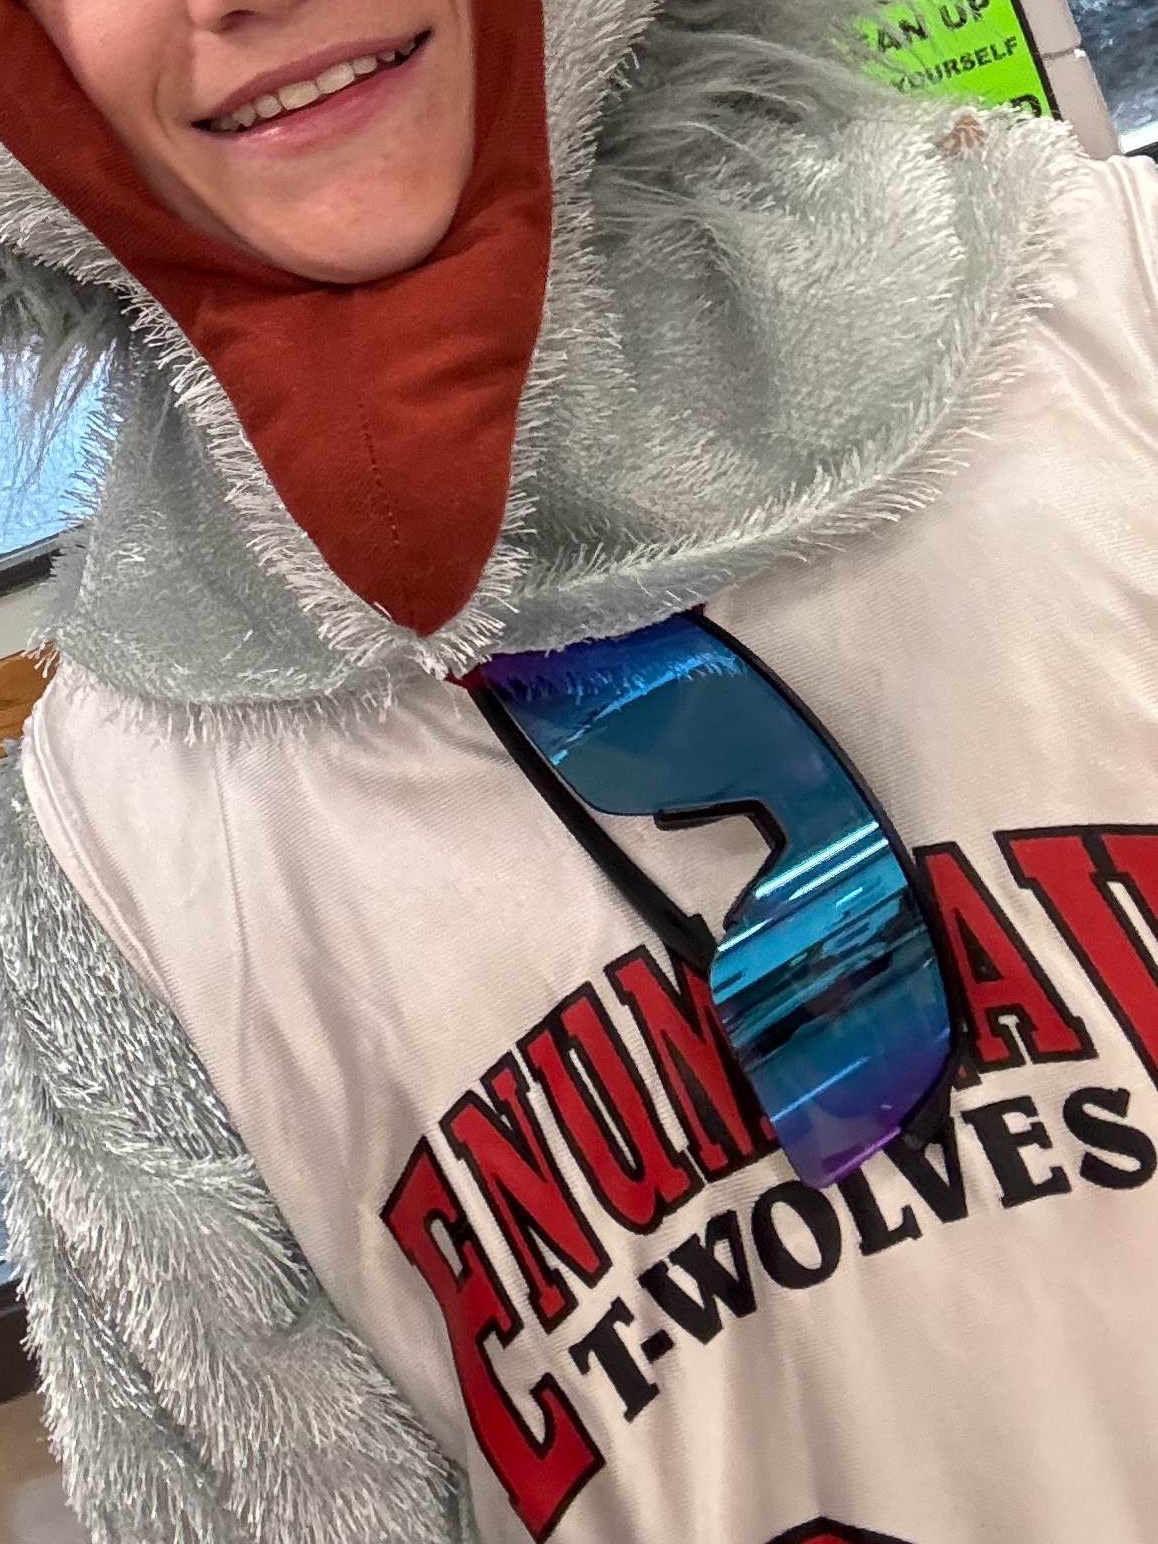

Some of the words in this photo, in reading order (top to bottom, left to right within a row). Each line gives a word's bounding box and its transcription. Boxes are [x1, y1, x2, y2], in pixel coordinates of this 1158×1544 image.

[876, 19, 929, 54] AN
[892, 35, 1018, 94] YOURSELF
[568, 1086, 1158, 1423] T-WOLVES
